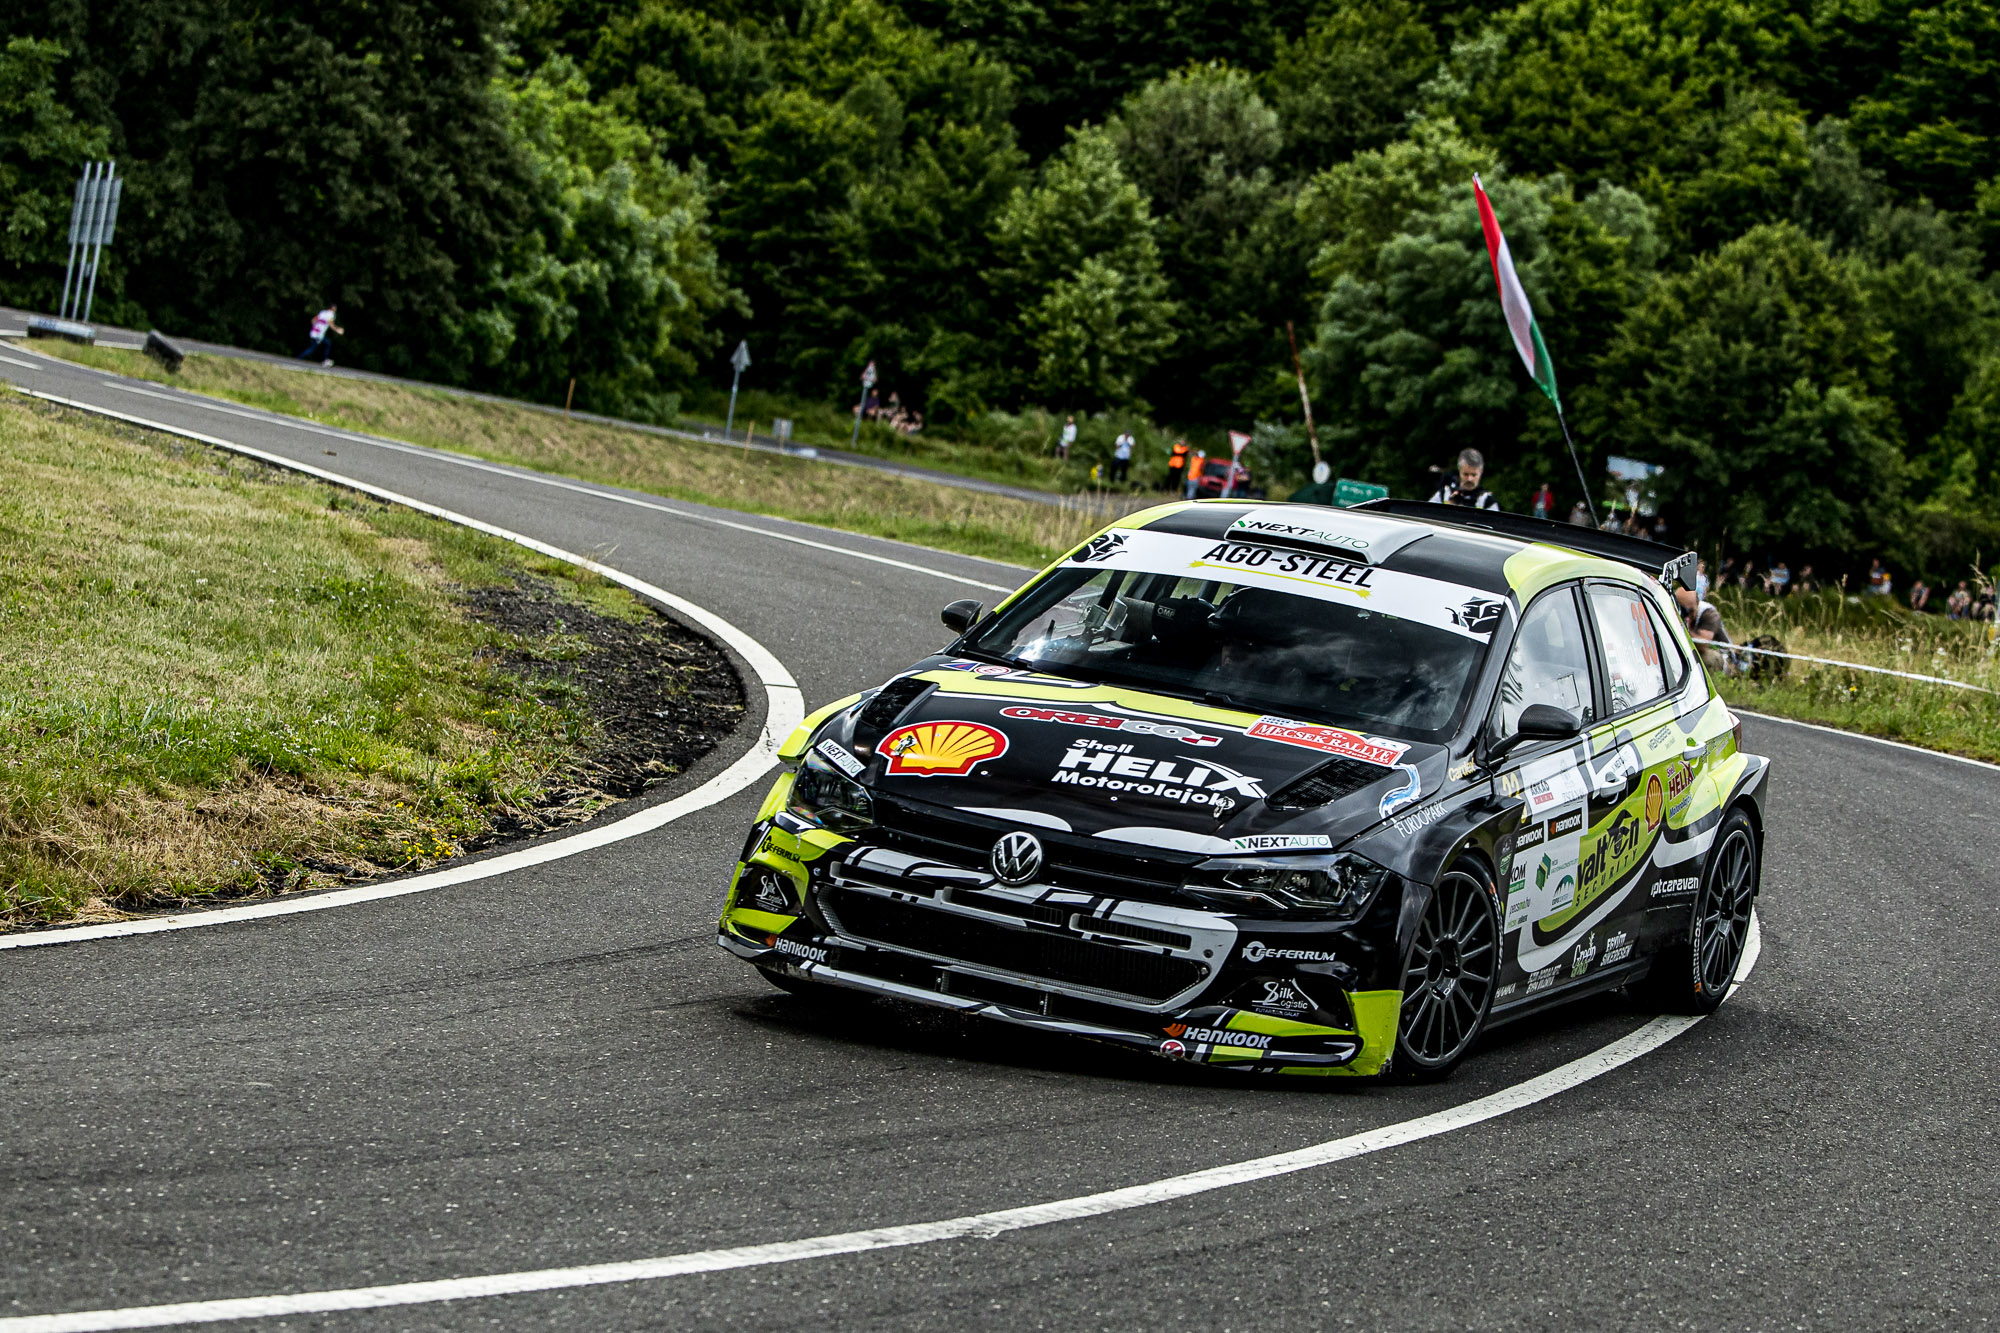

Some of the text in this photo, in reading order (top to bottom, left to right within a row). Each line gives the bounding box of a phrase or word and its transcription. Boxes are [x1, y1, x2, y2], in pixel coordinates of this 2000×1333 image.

[1249, 521, 1369, 549] NEXTAUTO
[1201, 543, 1374, 588] AGO-STEEL
[1631, 602, 1658, 666] 33
[1072, 739, 1134, 754] Shell
[1257, 724, 1394, 761] MECSEK RALLYE
[1320, 729, 1348, 740] 56.
[822, 744, 861, 774] NEXTAUTO
[1058, 748, 1268, 799] HELIX
[1668, 761, 1695, 801] HELIX
[1247, 837, 1329, 849] NEXTAUTO
[1575, 848, 1638, 908] SECURITY
